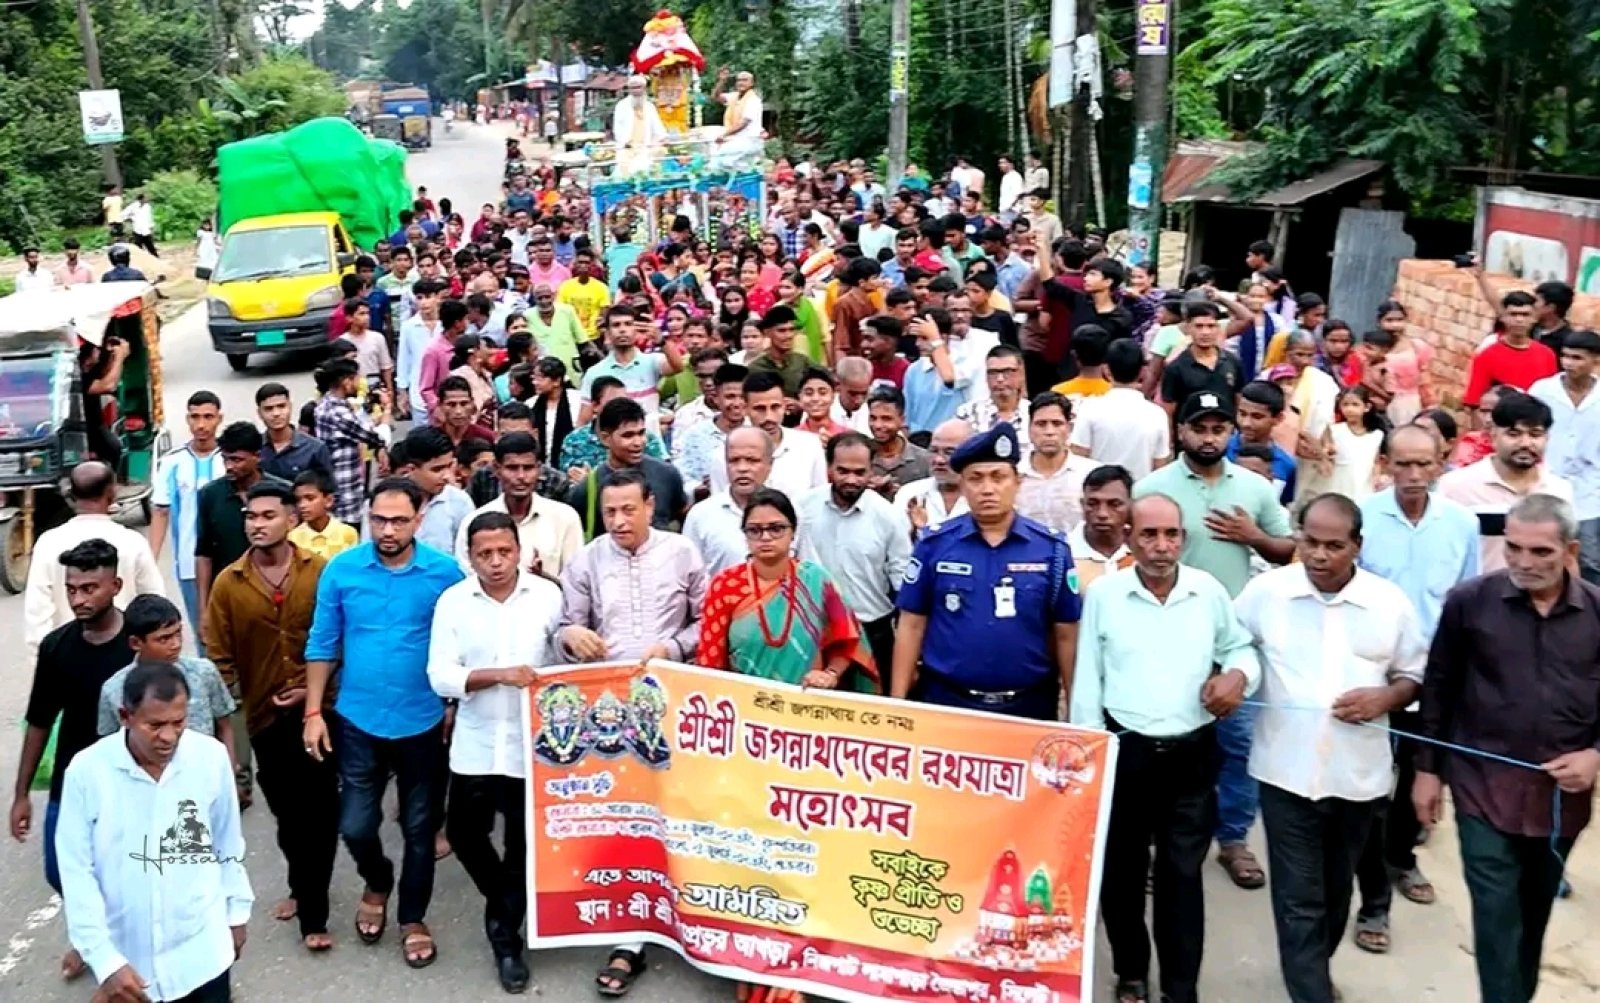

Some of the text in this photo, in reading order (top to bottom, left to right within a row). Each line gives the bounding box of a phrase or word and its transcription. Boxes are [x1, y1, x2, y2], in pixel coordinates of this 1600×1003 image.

[860, 712, 881, 726] তে
[679, 695, 736, 757] শ্রীশ্রী
[744, 723, 911, 782] জগন্নাথদেবের
[922, 750, 1025, 798] রথযাত্রা
[770, 785, 912, 837] মহোৎসব
[871, 850, 950, 882] সবাইকে
[576, 899, 610, 926] স্থান
[584, 868, 622, 887] এতে
[683, 883, 808, 926] আমন্ত্রিত
[850, 873, 964, 913] কৃষ্ণ প্রীতি ও
